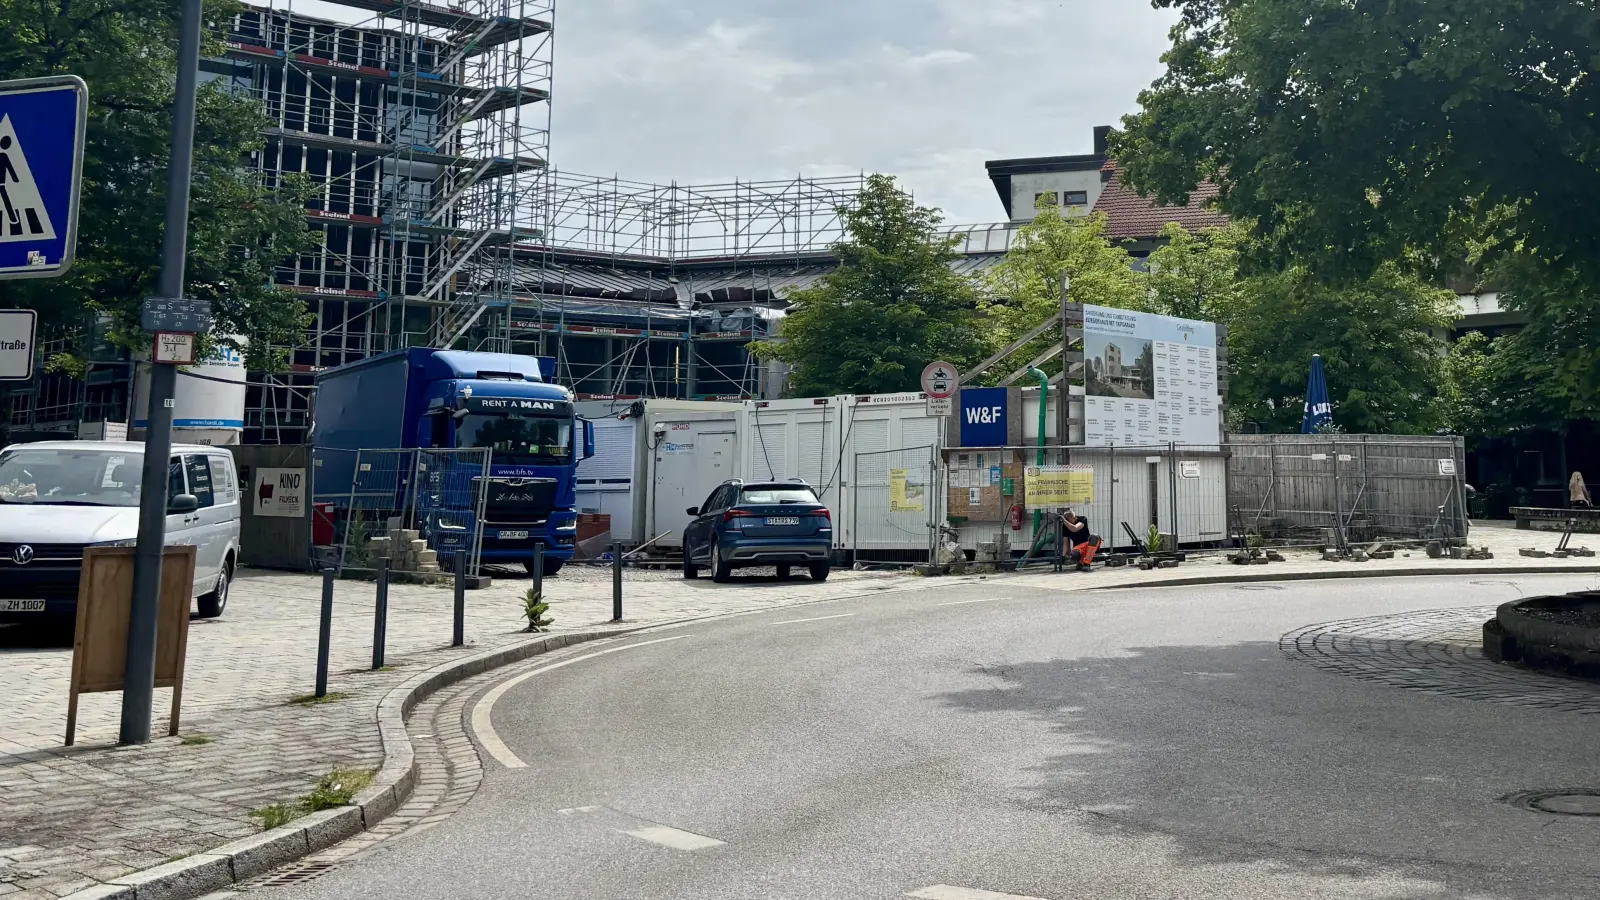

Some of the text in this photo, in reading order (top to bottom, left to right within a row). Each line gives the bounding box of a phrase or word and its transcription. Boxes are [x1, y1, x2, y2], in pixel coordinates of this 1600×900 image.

[328, 59, 359, 71] Steinel
[320, 211, 350, 219] Steinel
[314, 287, 346, 295] Steinel
[167, 302, 173, 310] S
[189, 304, 195, 312] S
[521, 401, 554, 410] MAN
[965, 406, 1002, 424] W&F
[498, 468, 534, 476] www.bfs.tv
[279, 473, 300, 489] KINO
[7, 600, 45, 610] ZH 1007
